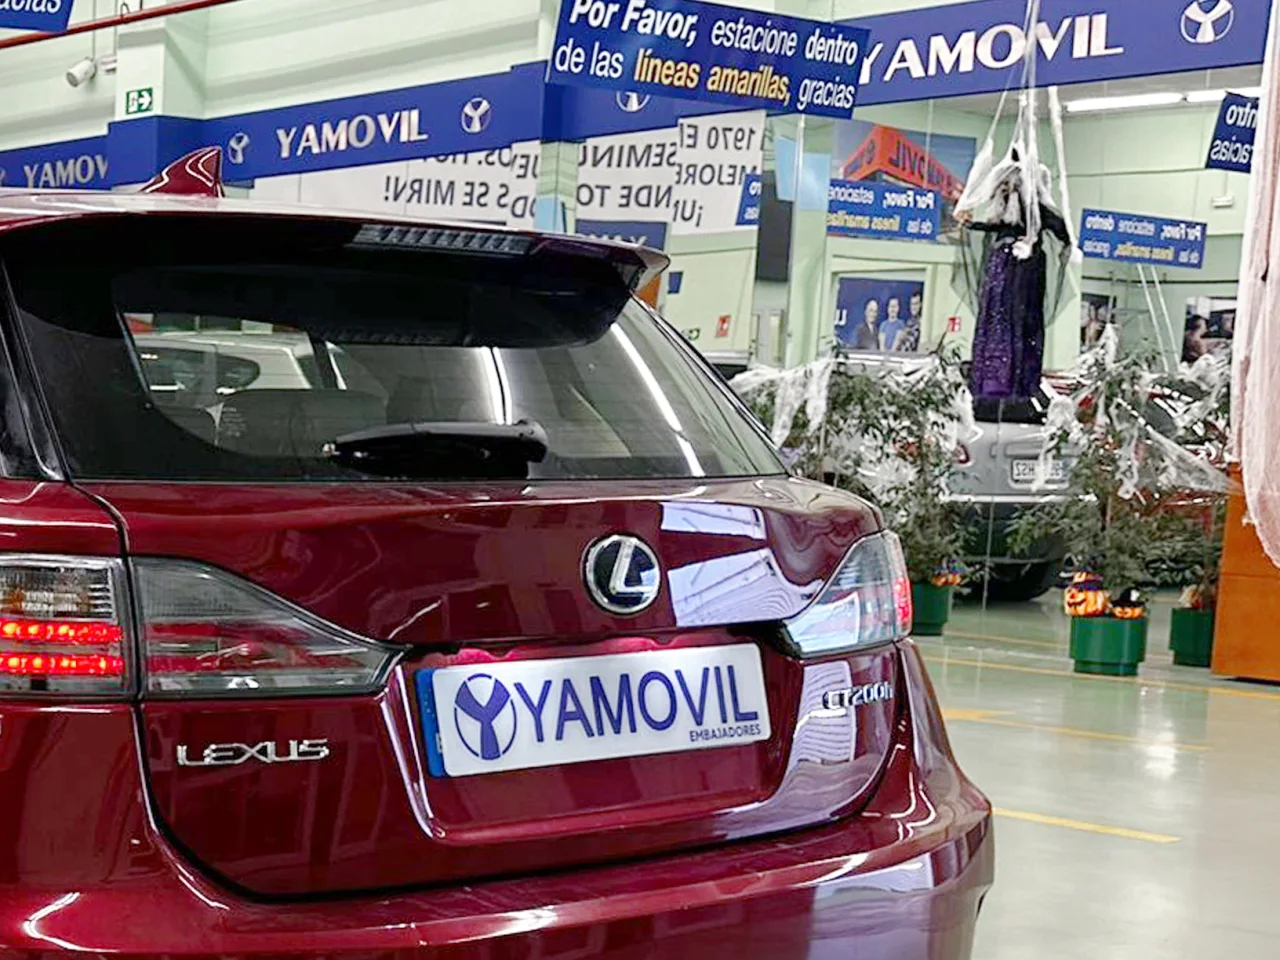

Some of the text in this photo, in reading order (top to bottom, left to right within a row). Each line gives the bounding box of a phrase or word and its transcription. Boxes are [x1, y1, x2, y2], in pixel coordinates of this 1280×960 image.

[569, 0, 858, 66] Por Favor, estacione dentro
[554, 38, 856, 111] de las líneas amarillas, gracias
[276, 108, 429, 159] YAMOVIL
[512, 664, 759, 744] YAMOVIL
[823, 681, 894, 710] CT200h
[176, 739, 329, 766] LEXUS
[689, 723, 762, 742] EMBAJADORES
